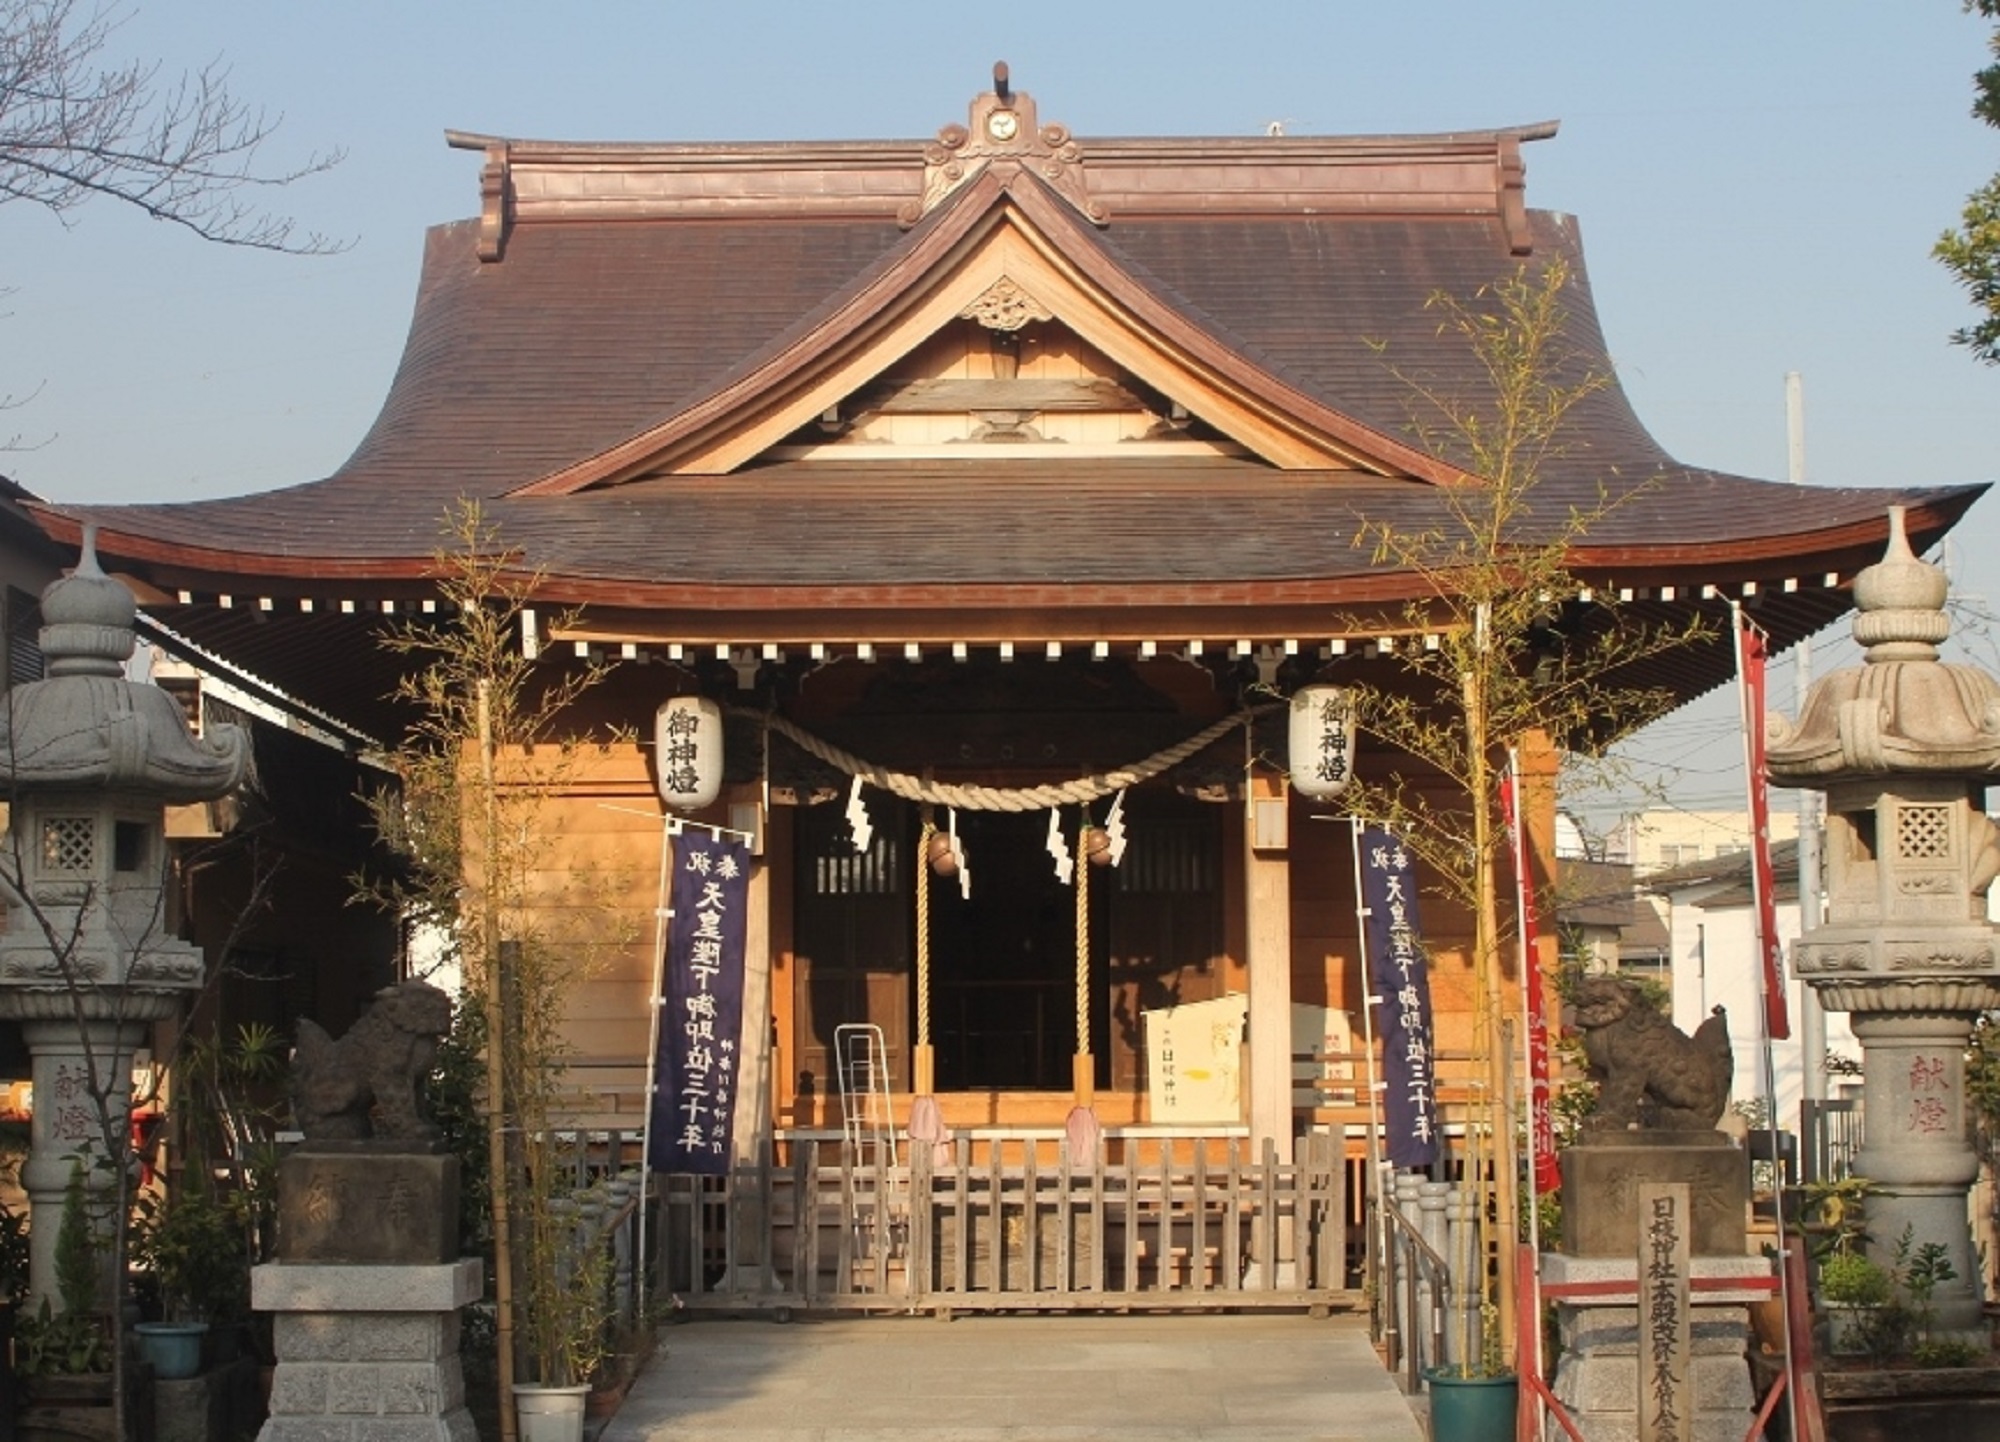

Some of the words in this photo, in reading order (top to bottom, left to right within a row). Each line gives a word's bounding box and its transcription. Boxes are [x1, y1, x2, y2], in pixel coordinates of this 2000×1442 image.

[666, 706, 700, 793] 御神燈
[1316, 696, 1347, 783] 御神燈
